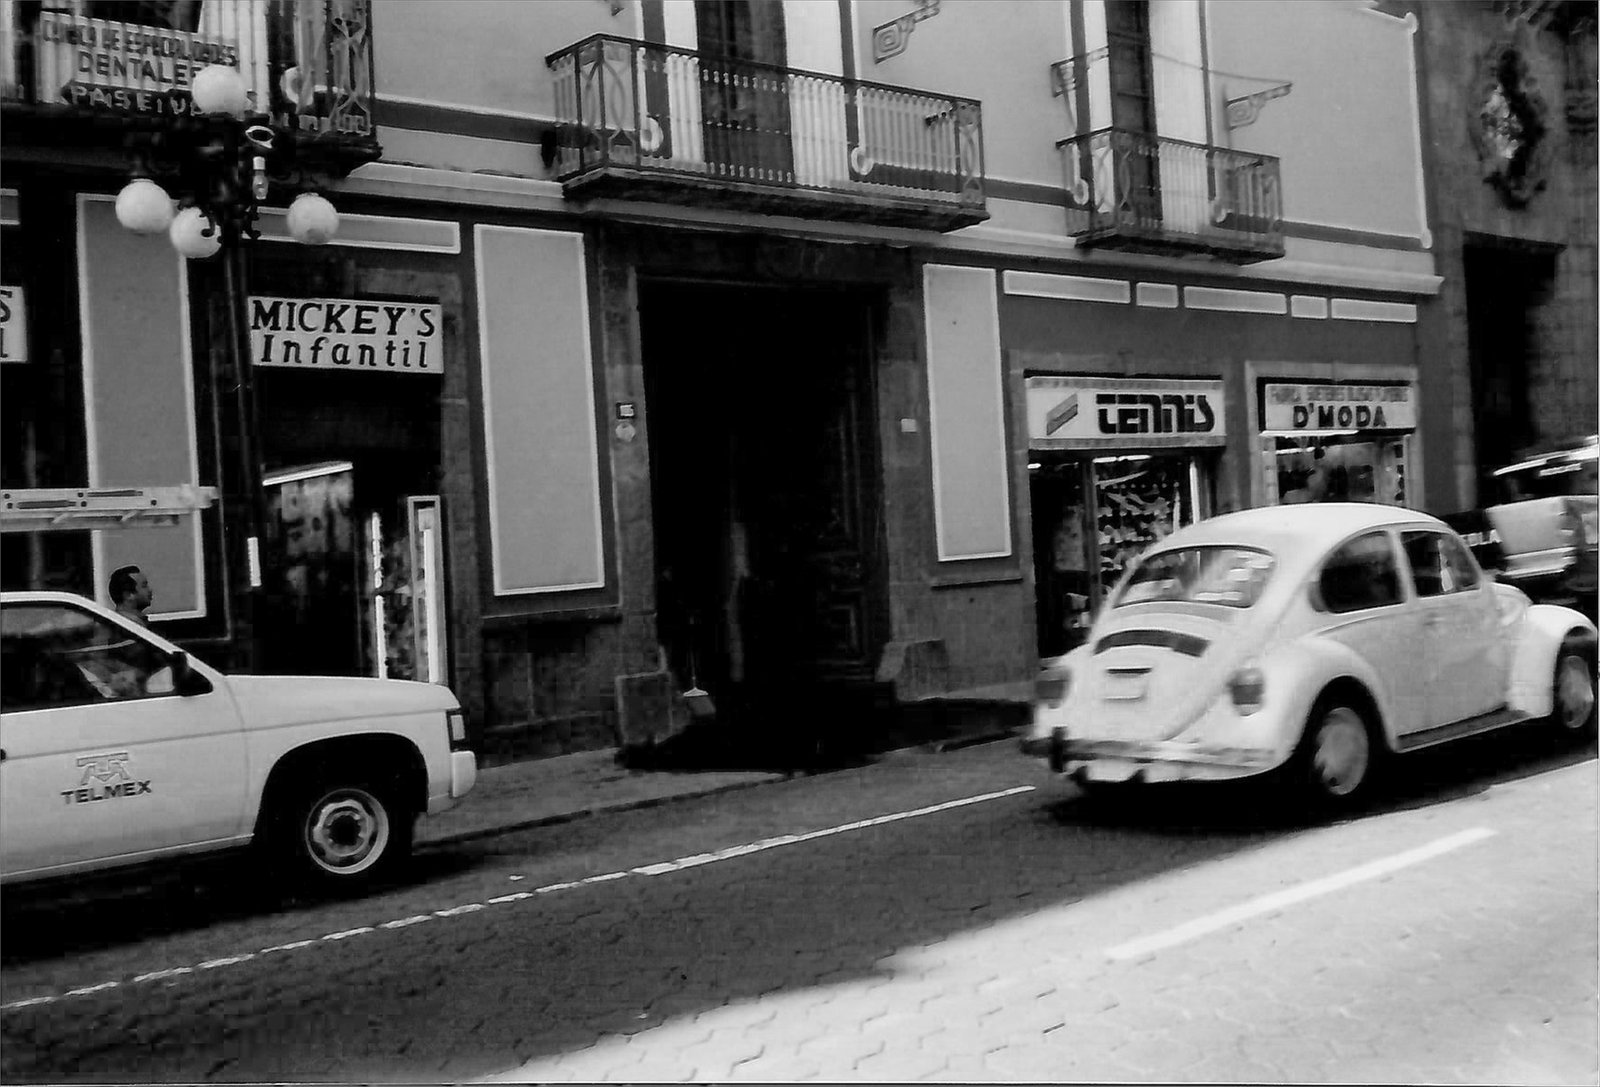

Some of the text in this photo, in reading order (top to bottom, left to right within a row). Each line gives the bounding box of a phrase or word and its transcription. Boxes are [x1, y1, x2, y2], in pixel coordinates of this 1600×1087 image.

[251, 299, 436, 338] MICKEY'S
[261, 335, 429, 369] Infantil
[1293, 402, 1387, 428] D'MODA
[60, 780, 152, 805] TELMEX
